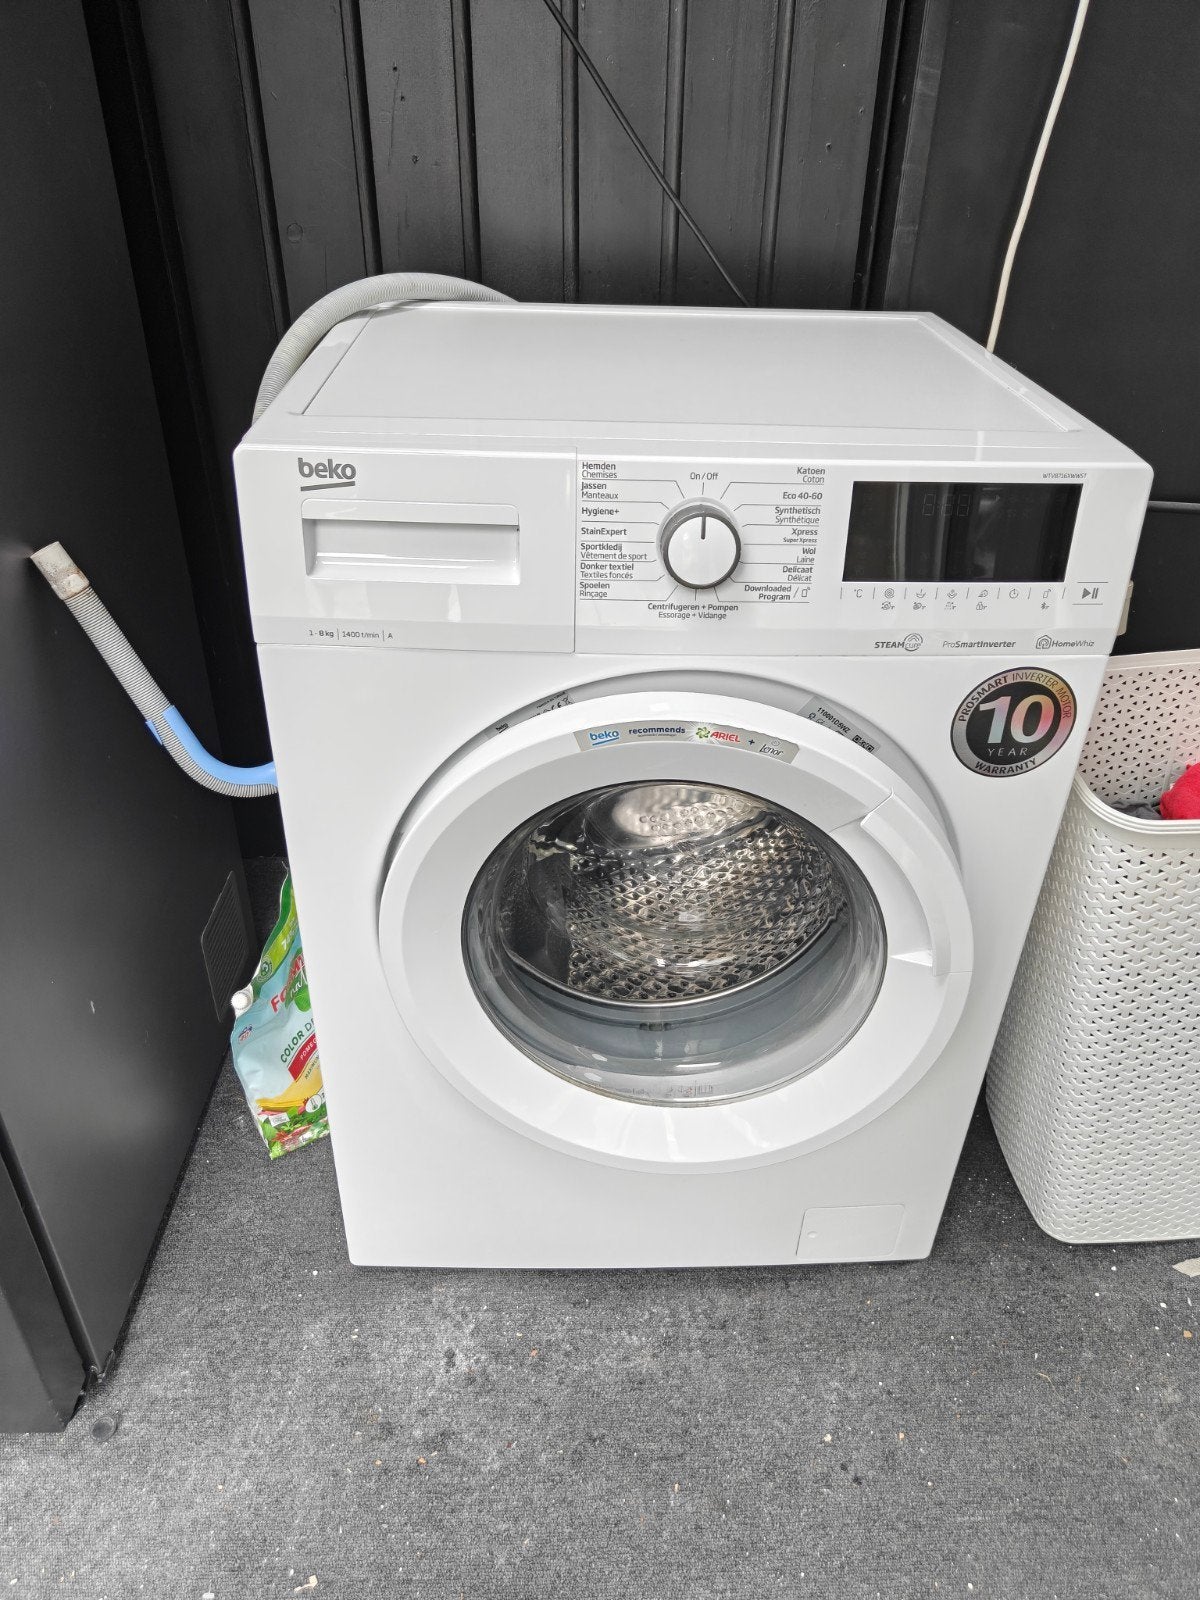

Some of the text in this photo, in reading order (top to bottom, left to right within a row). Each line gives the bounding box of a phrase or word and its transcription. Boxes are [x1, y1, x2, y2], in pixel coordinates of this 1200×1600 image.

[298, 457, 357, 480] beko
[582, 461, 616, 470] Hemden
[582, 469, 618, 479] Chemises
[797, 467, 826, 475] Katoen
[802, 475, 825, 483] Coton
[581, 481, 607, 491] Jassen
[581, 491, 619, 500] Manteaux
[783, 491, 823, 500] Eco 40-60
[581, 506, 620, 517] Hygiene+
[775, 506, 821, 516] Synthetisch
[775, 515, 820, 525] Synthétique
[581, 526, 627, 537] StainExpert
[791, 527, 818, 537] Xpress
[580, 542, 623, 553] Sportkledij
[802, 547, 816, 555] Wol
[580, 551, 648, 562] Vêtement de sport
[796, 555, 815, 564] Laine
[580, 562, 635, 571] Donker textiel
[782, 565, 814, 574] Delicaat
[580, 571, 634, 580] Textiles foncés
[787, 574, 812, 582] Délicat
[579, 581, 610, 591] Spoelen
[744, 584, 792, 593] Downloaded
[579, 589, 608, 599] Rinçage
[758, 592, 791, 602] Program
[647, 602, 700, 612] Centrifugeren
[707, 603, 739, 612] Pompen
[658, 611, 691, 620] Essorage
[698, 612, 727, 621] Vidange
[342, 630, 361, 638] 1400
[942, 640, 1017, 649] ProSmartInverter
[1052, 640, 1095, 648] HomeWhiz
[958, 672, 1072, 722] PROSMART INVERTER MOTOR
[979, 694, 1055, 744] 10
[589, 730, 620, 742] beko
[628, 726, 686, 736] recommends
[710, 731, 741, 743] ARIEL
[759, 743, 784, 757] Lenor
[988, 747, 1028, 758] YEAR
[975, 757, 1037, 775] WARRANTY
[280, 1030, 305, 1064] COLOR
